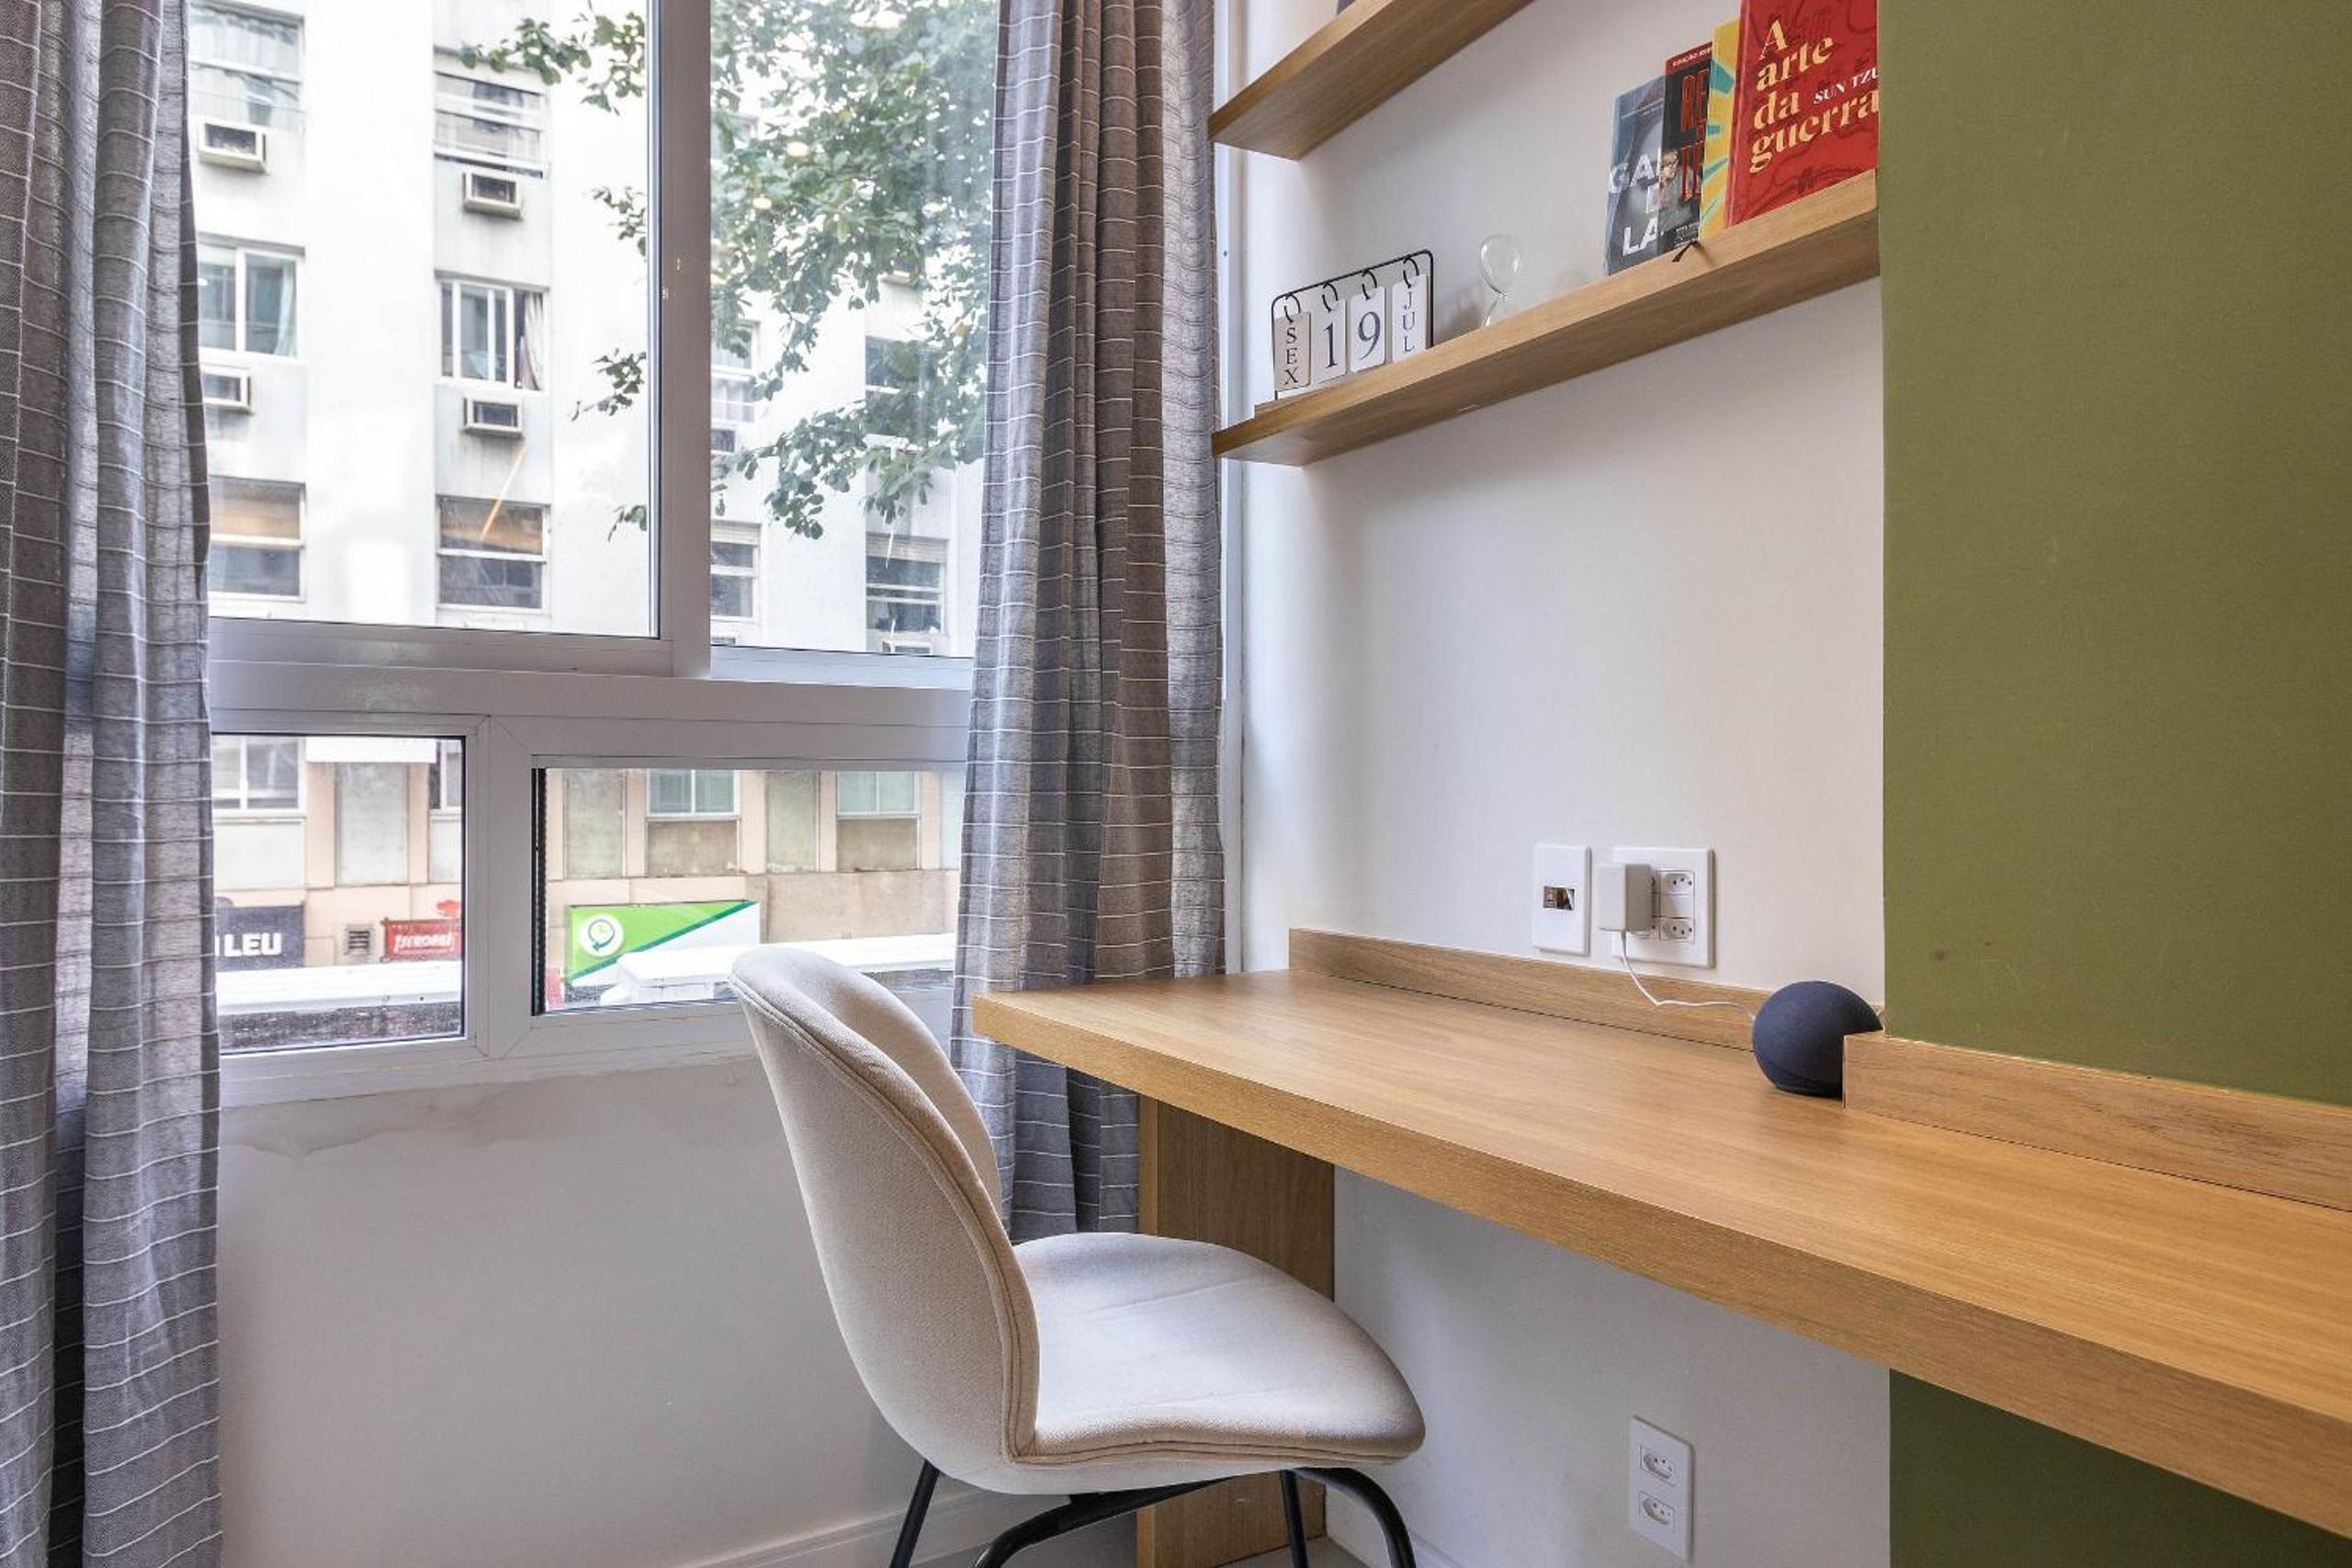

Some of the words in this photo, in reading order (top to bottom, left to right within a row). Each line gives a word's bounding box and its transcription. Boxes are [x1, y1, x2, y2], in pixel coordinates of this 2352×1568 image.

[1758, 18, 1789, 60] A
[1756, 36, 1834, 92] arte
[1754, 90, 1800, 130] da
[1813, 82, 1846, 105] SUN
[1749, 89, 1880, 174] guerra
[1402, 291, 1416, 353] JUL
[1284, 326, 1298, 386] SEX
[223, 931, 282, 957] LEU
